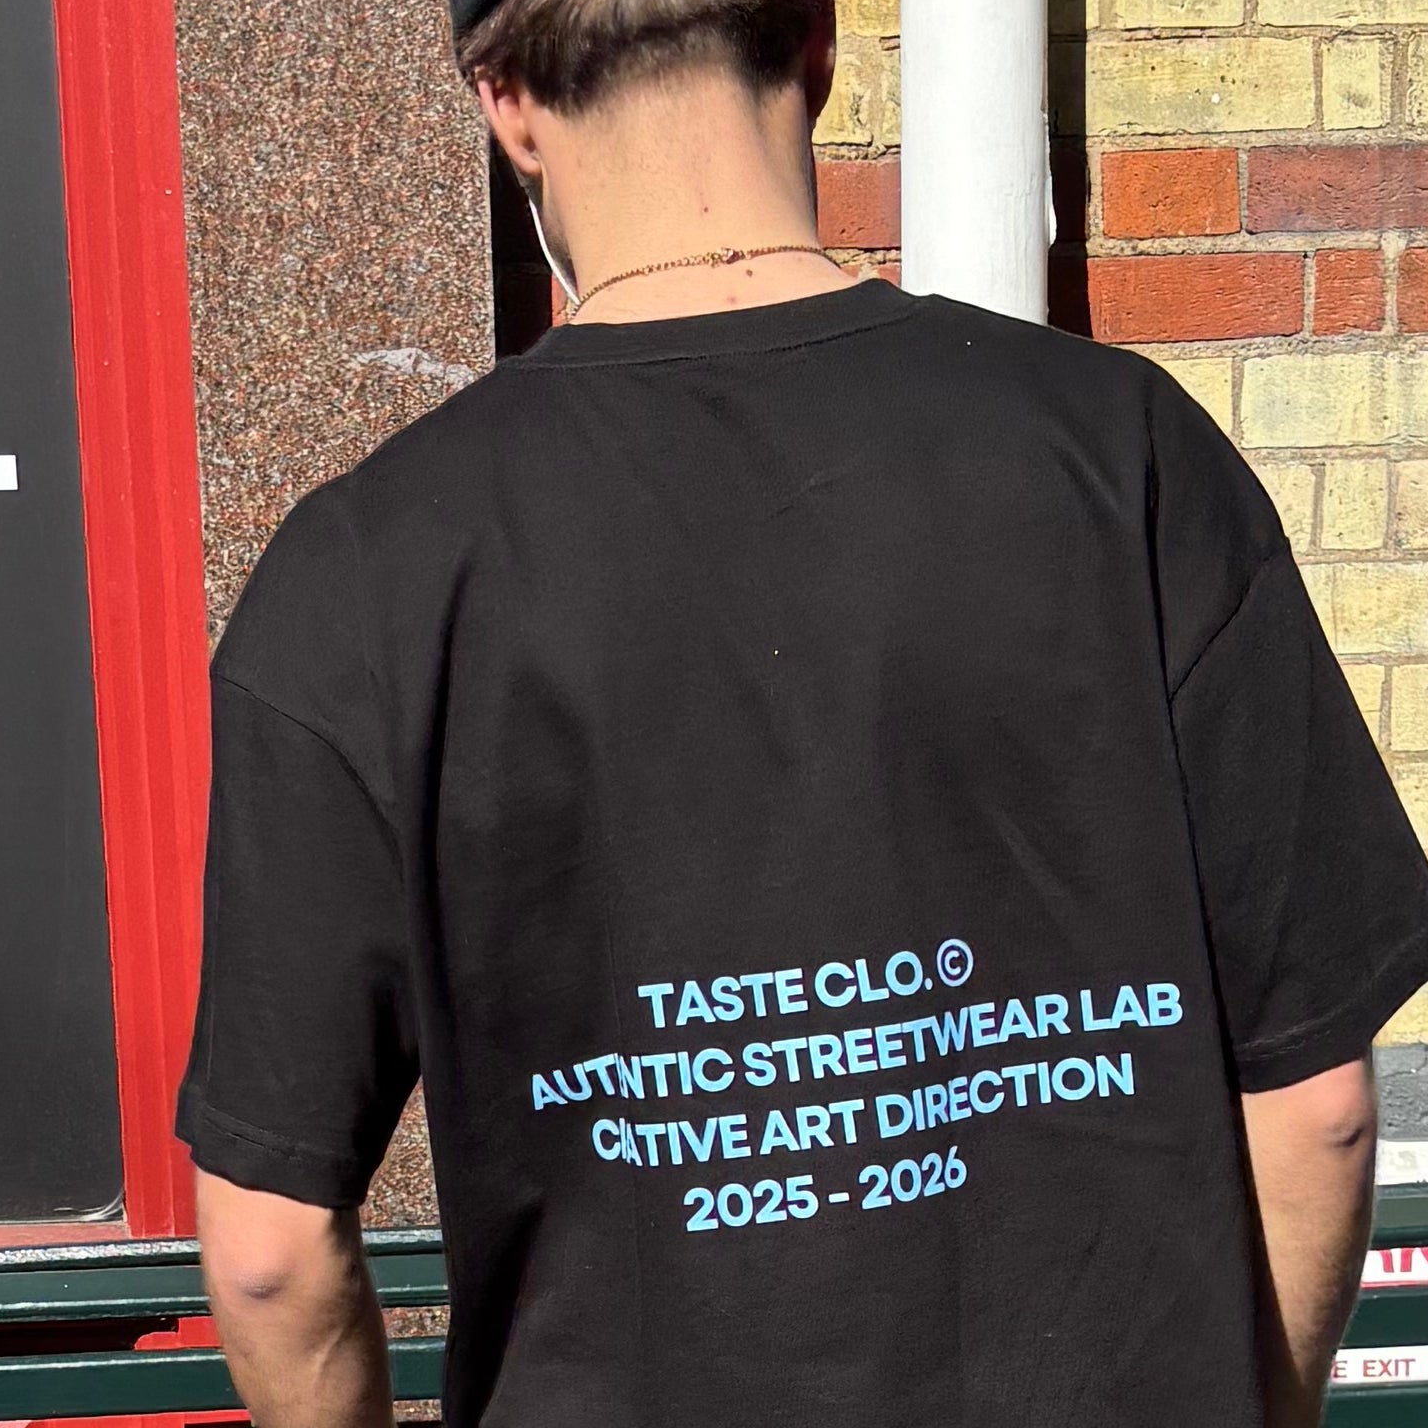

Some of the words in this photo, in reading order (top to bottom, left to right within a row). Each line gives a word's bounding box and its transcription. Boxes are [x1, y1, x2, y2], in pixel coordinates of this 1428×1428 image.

[638, 969, 808, 1028] TASTE
[743, 994, 1070, 1086] STREETWEAR
[1080, 983, 1183, 1031] LAB
[760, 1100, 864, 1154] ART
[876, 1053, 1134, 1138] DIRECTION
[684, 1175, 817, 1231] 2025
[859, 1147, 967, 1209] 2026
[1363, 1358, 1416, 1377] EXIT
